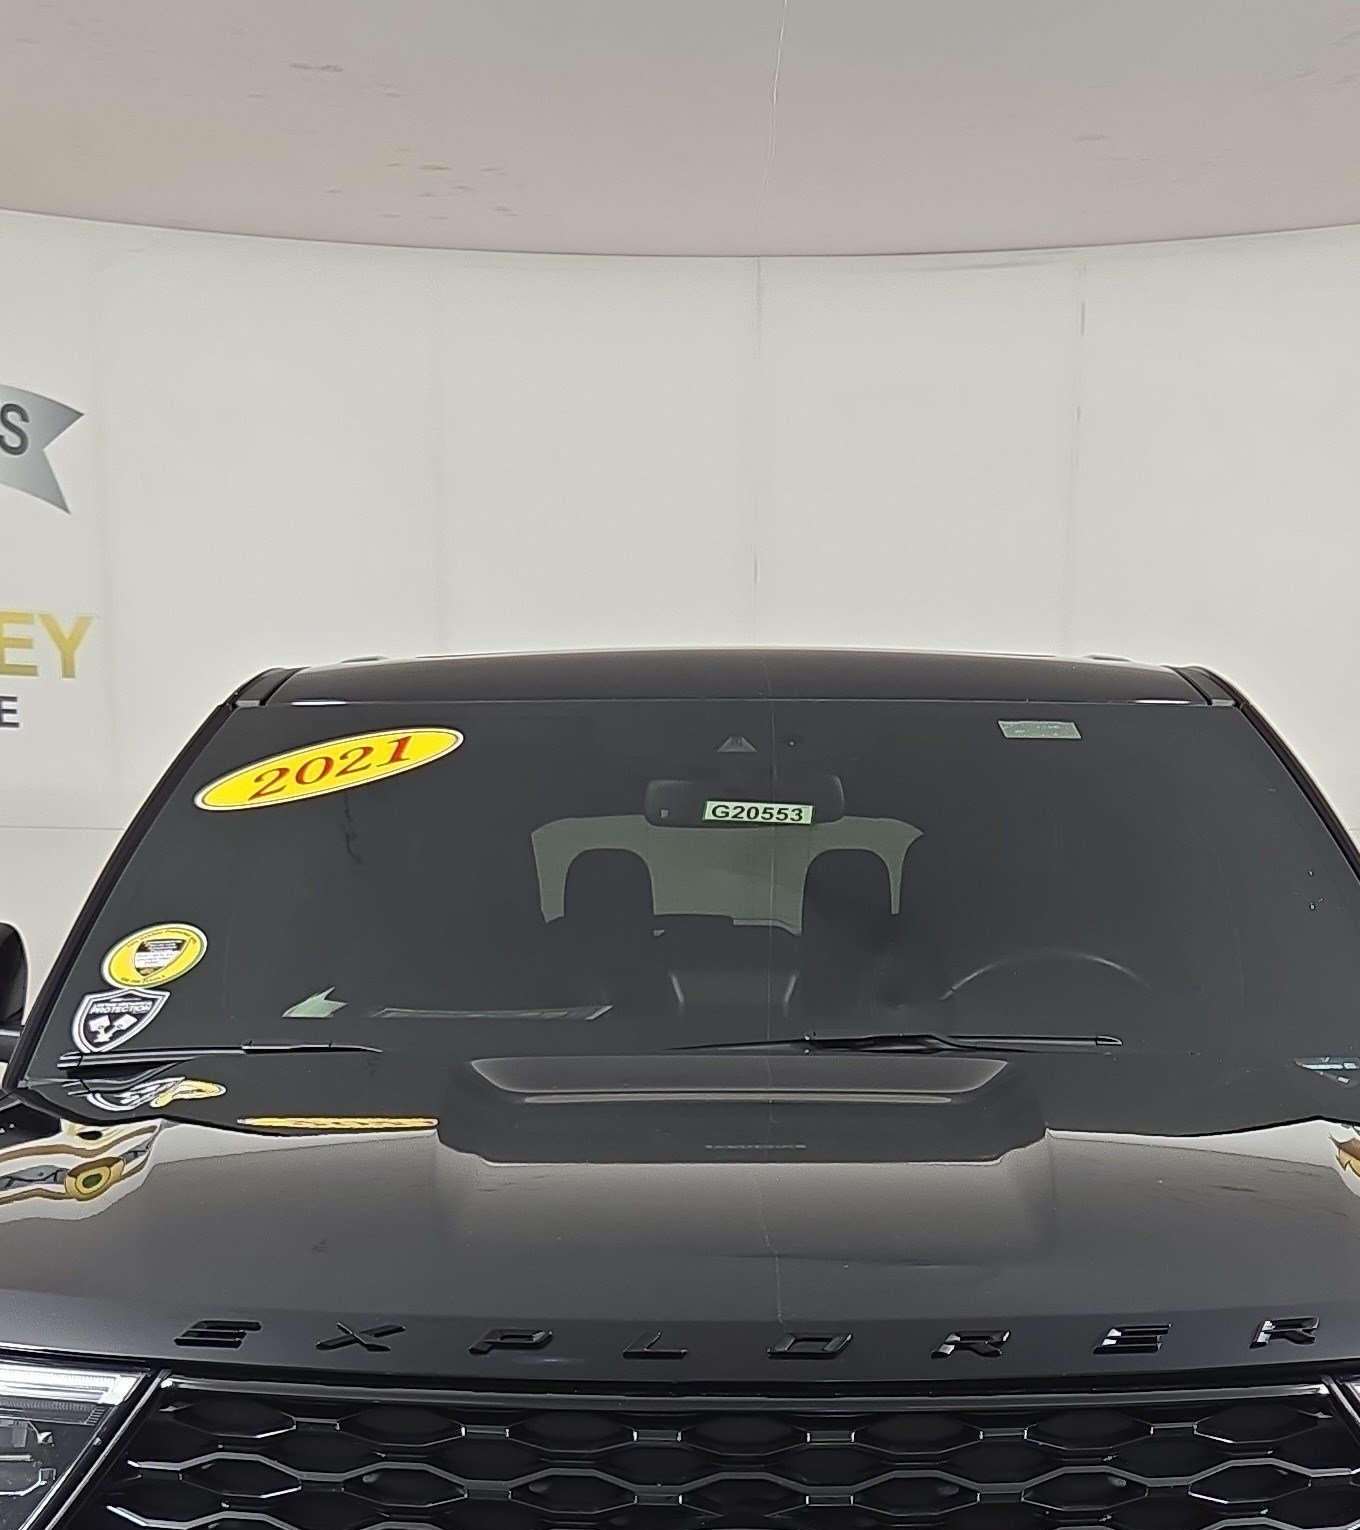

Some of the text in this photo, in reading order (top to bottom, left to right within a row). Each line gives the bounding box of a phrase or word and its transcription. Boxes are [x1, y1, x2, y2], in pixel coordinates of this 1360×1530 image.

[247, 736, 413, 801] 2021
[711, 803, 804, 823] G20553
[174, 1317, 1321, 1360] EXPLORER
